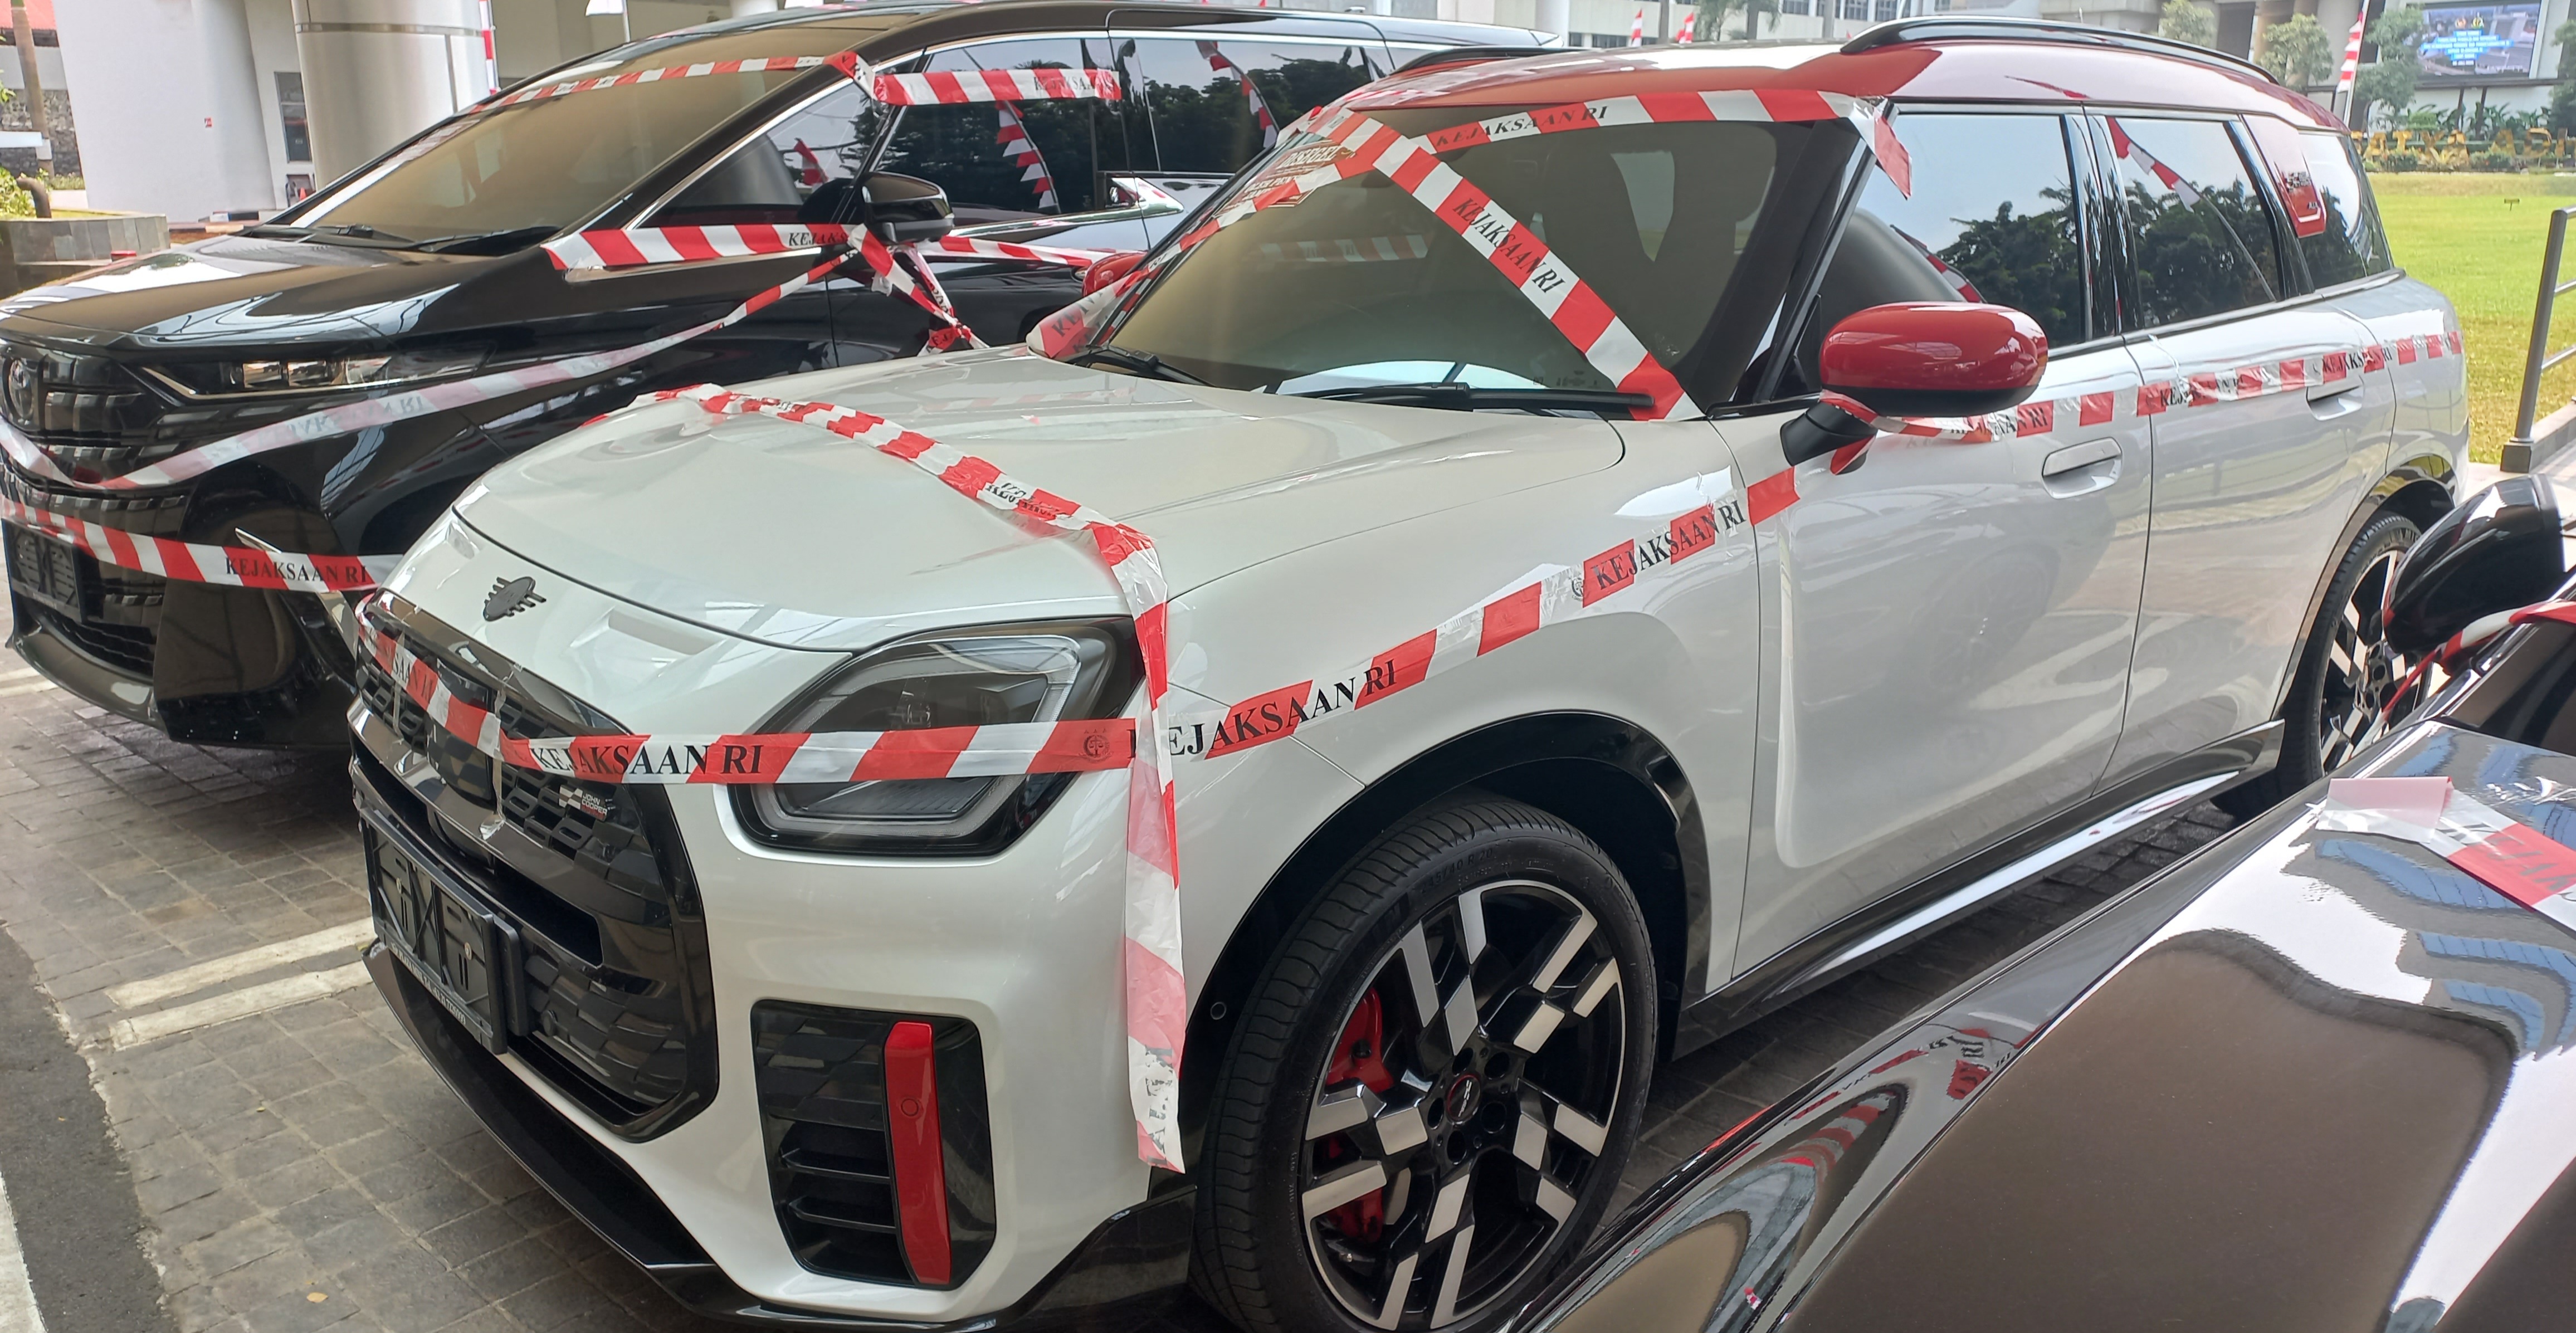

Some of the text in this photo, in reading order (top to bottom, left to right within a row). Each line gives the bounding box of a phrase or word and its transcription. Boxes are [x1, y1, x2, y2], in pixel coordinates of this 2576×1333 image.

[1436, 105, 1609, 147] KEJAKSAAN RI
[1280, 145, 1344, 167] DISEGEL
[1452, 198, 1566, 293] KEJAKSAAN RI
[1591, 500, 1747, 590] KEJAKSAAN RI
[226, 557, 367, 583] KEJAKSAAN RI
[1363, 659, 1398, 696] RI
[530, 744, 764, 775] KEJAKSAAN RI
[582, 799, 608, 816] COOPER
[583, 793, 601, 805] JOHN
